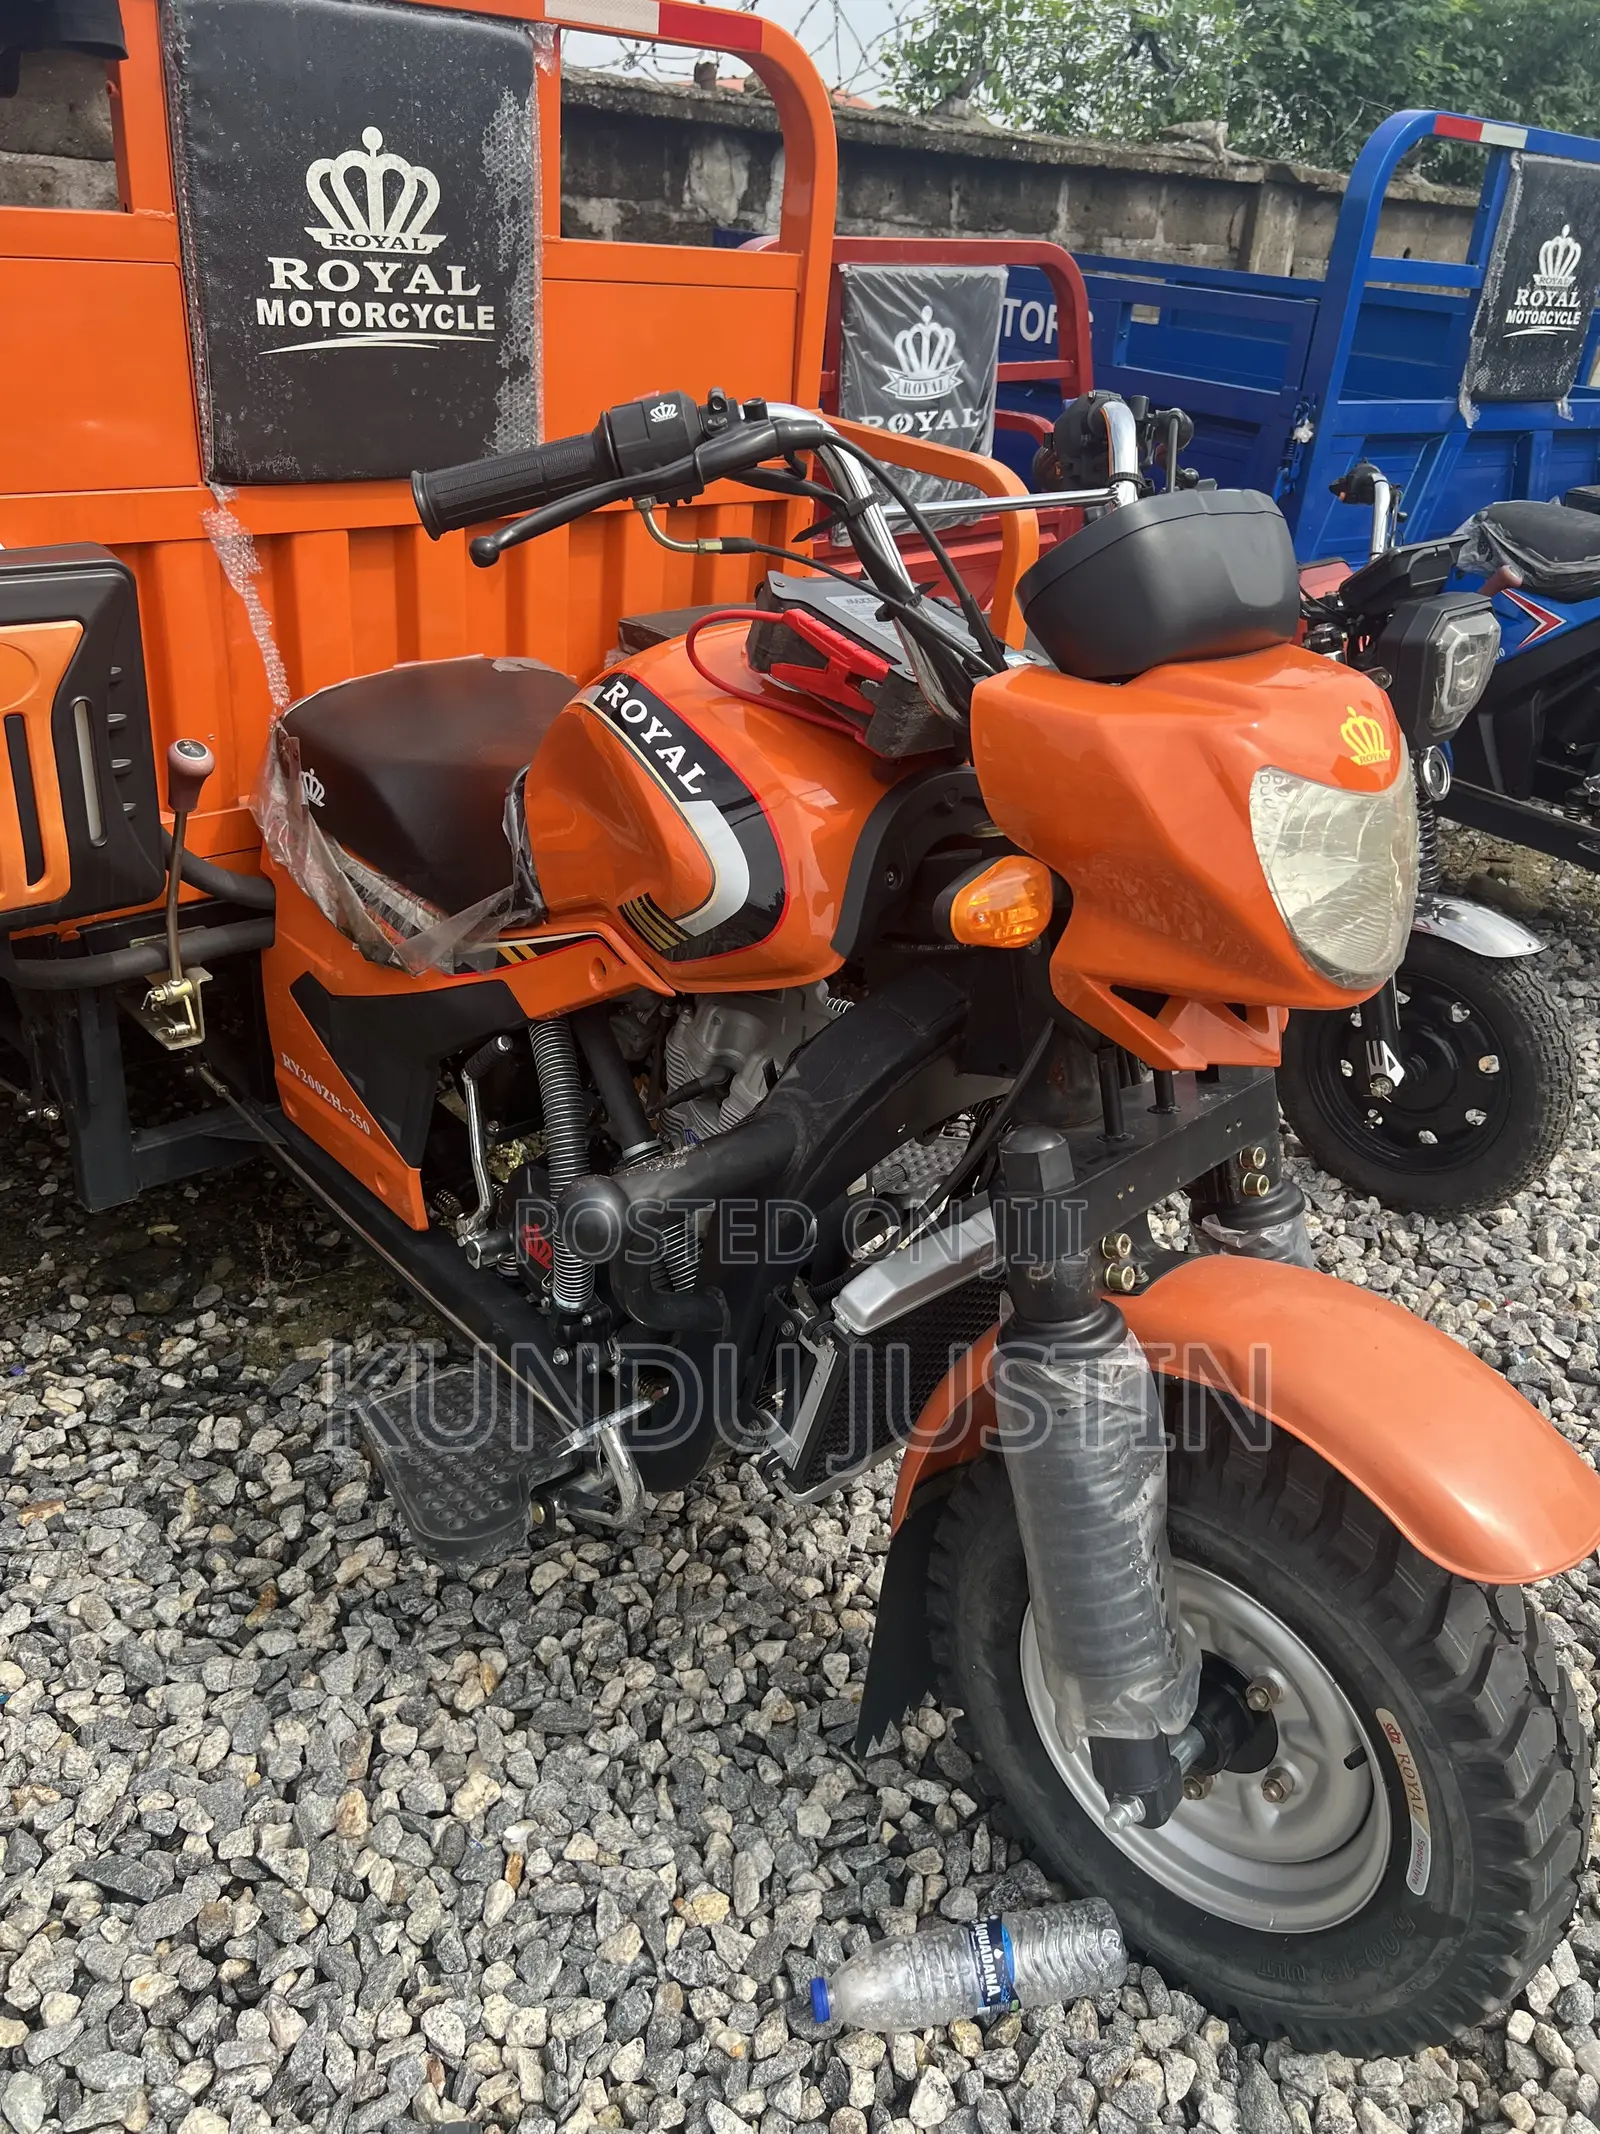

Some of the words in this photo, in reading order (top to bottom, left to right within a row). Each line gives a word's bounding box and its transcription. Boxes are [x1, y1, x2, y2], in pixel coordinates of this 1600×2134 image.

[329, 232, 428, 251] ROYAL
[267, 256, 481, 296] ROYAL
[1513, 287, 1581, 308] ROYAL
[256, 298, 496, 331] MOTORCYCLE
[1505, 309, 1582, 325] MOTORCYCLE
[903, 378, 946, 395] ROYAL
[602, 680, 706, 795] ROYAL
[1360, 751, 1389, 763] ROYAL
[281, 1051, 371, 1136] RY200ZH-250
[1397, 1752, 1425, 1816] ROYAL
